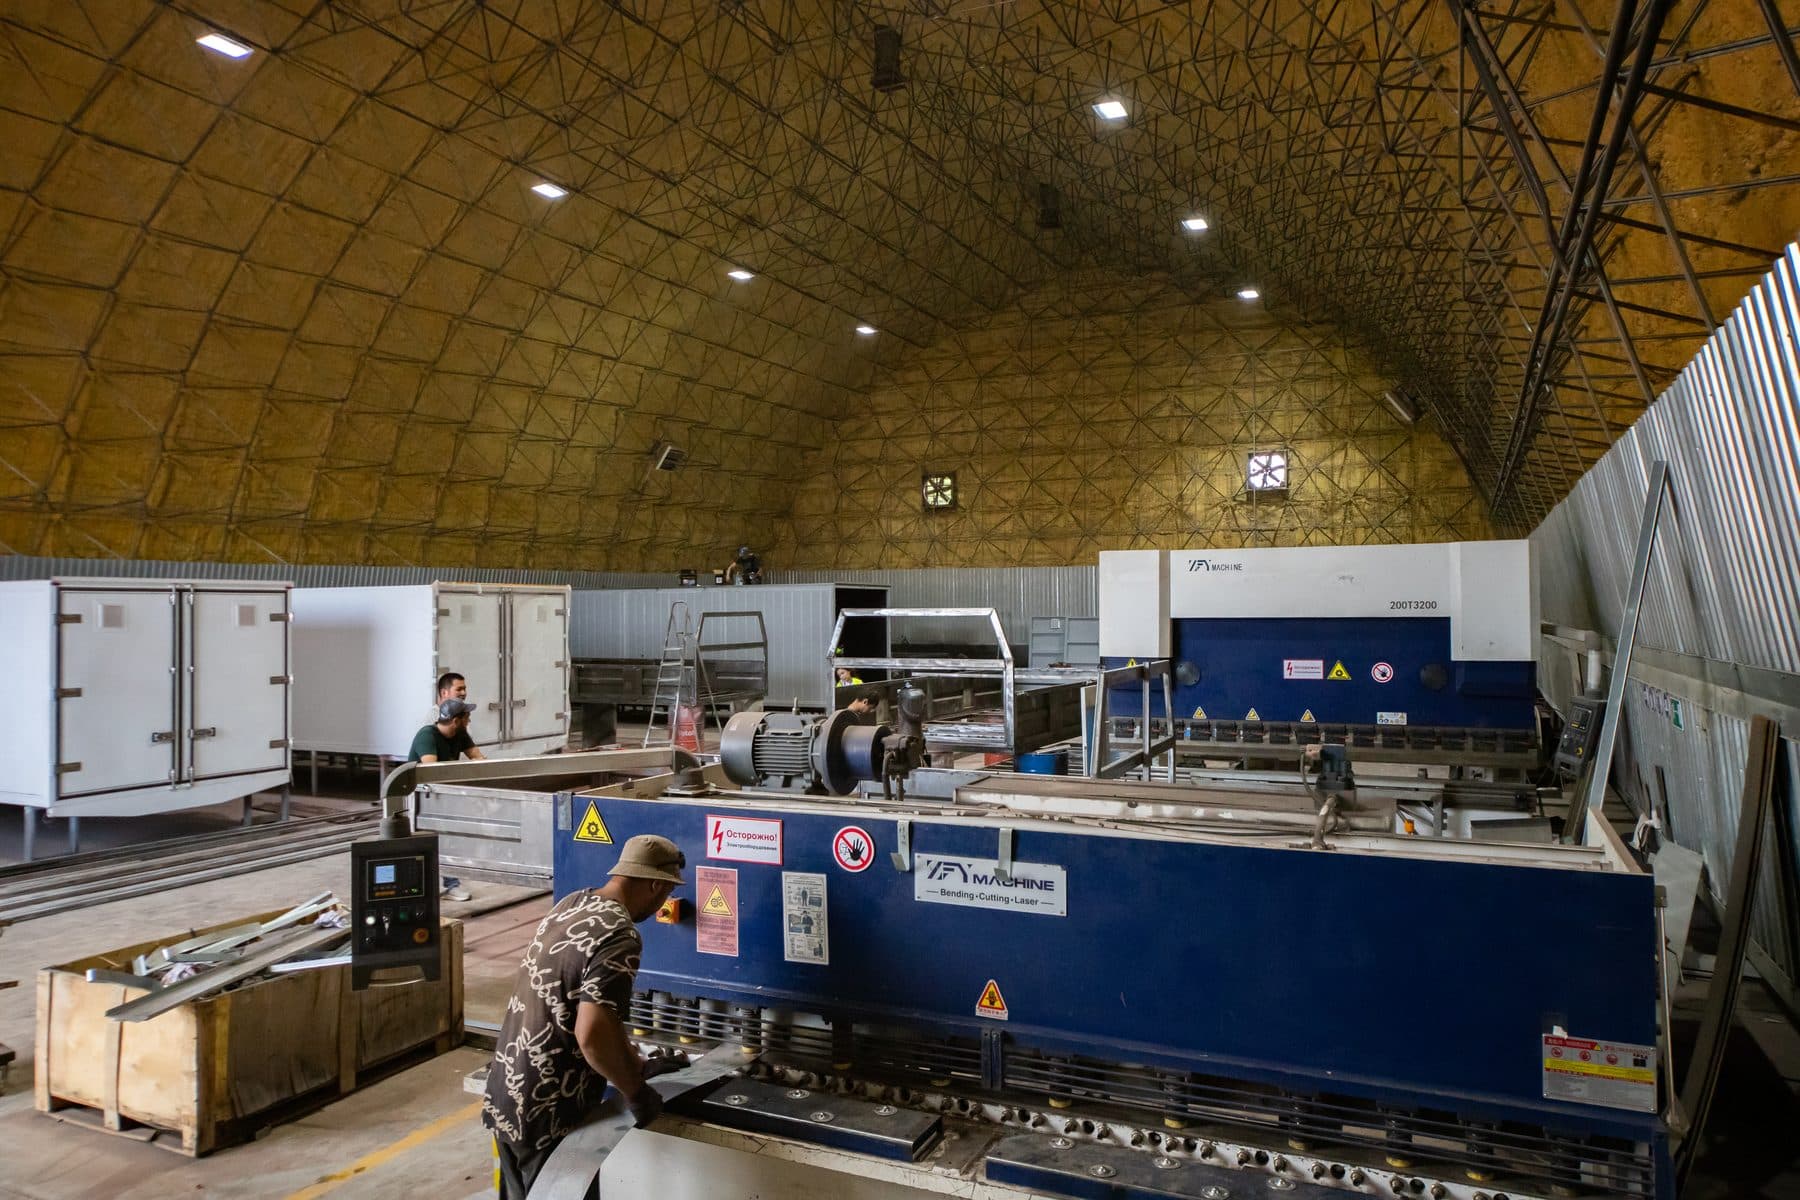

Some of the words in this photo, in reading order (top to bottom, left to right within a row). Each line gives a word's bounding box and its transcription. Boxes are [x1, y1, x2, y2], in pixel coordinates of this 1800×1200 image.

[1211, 563, 1243, 571] MACHINE
[1390, 600, 1437, 610] 200T3200
[726, 829, 777, 842] Осторожно!
[940, 888, 974, 901] Bending
[979, 892, 1010, 904] Cutting
[1014, 895, 1039, 905] Laser
